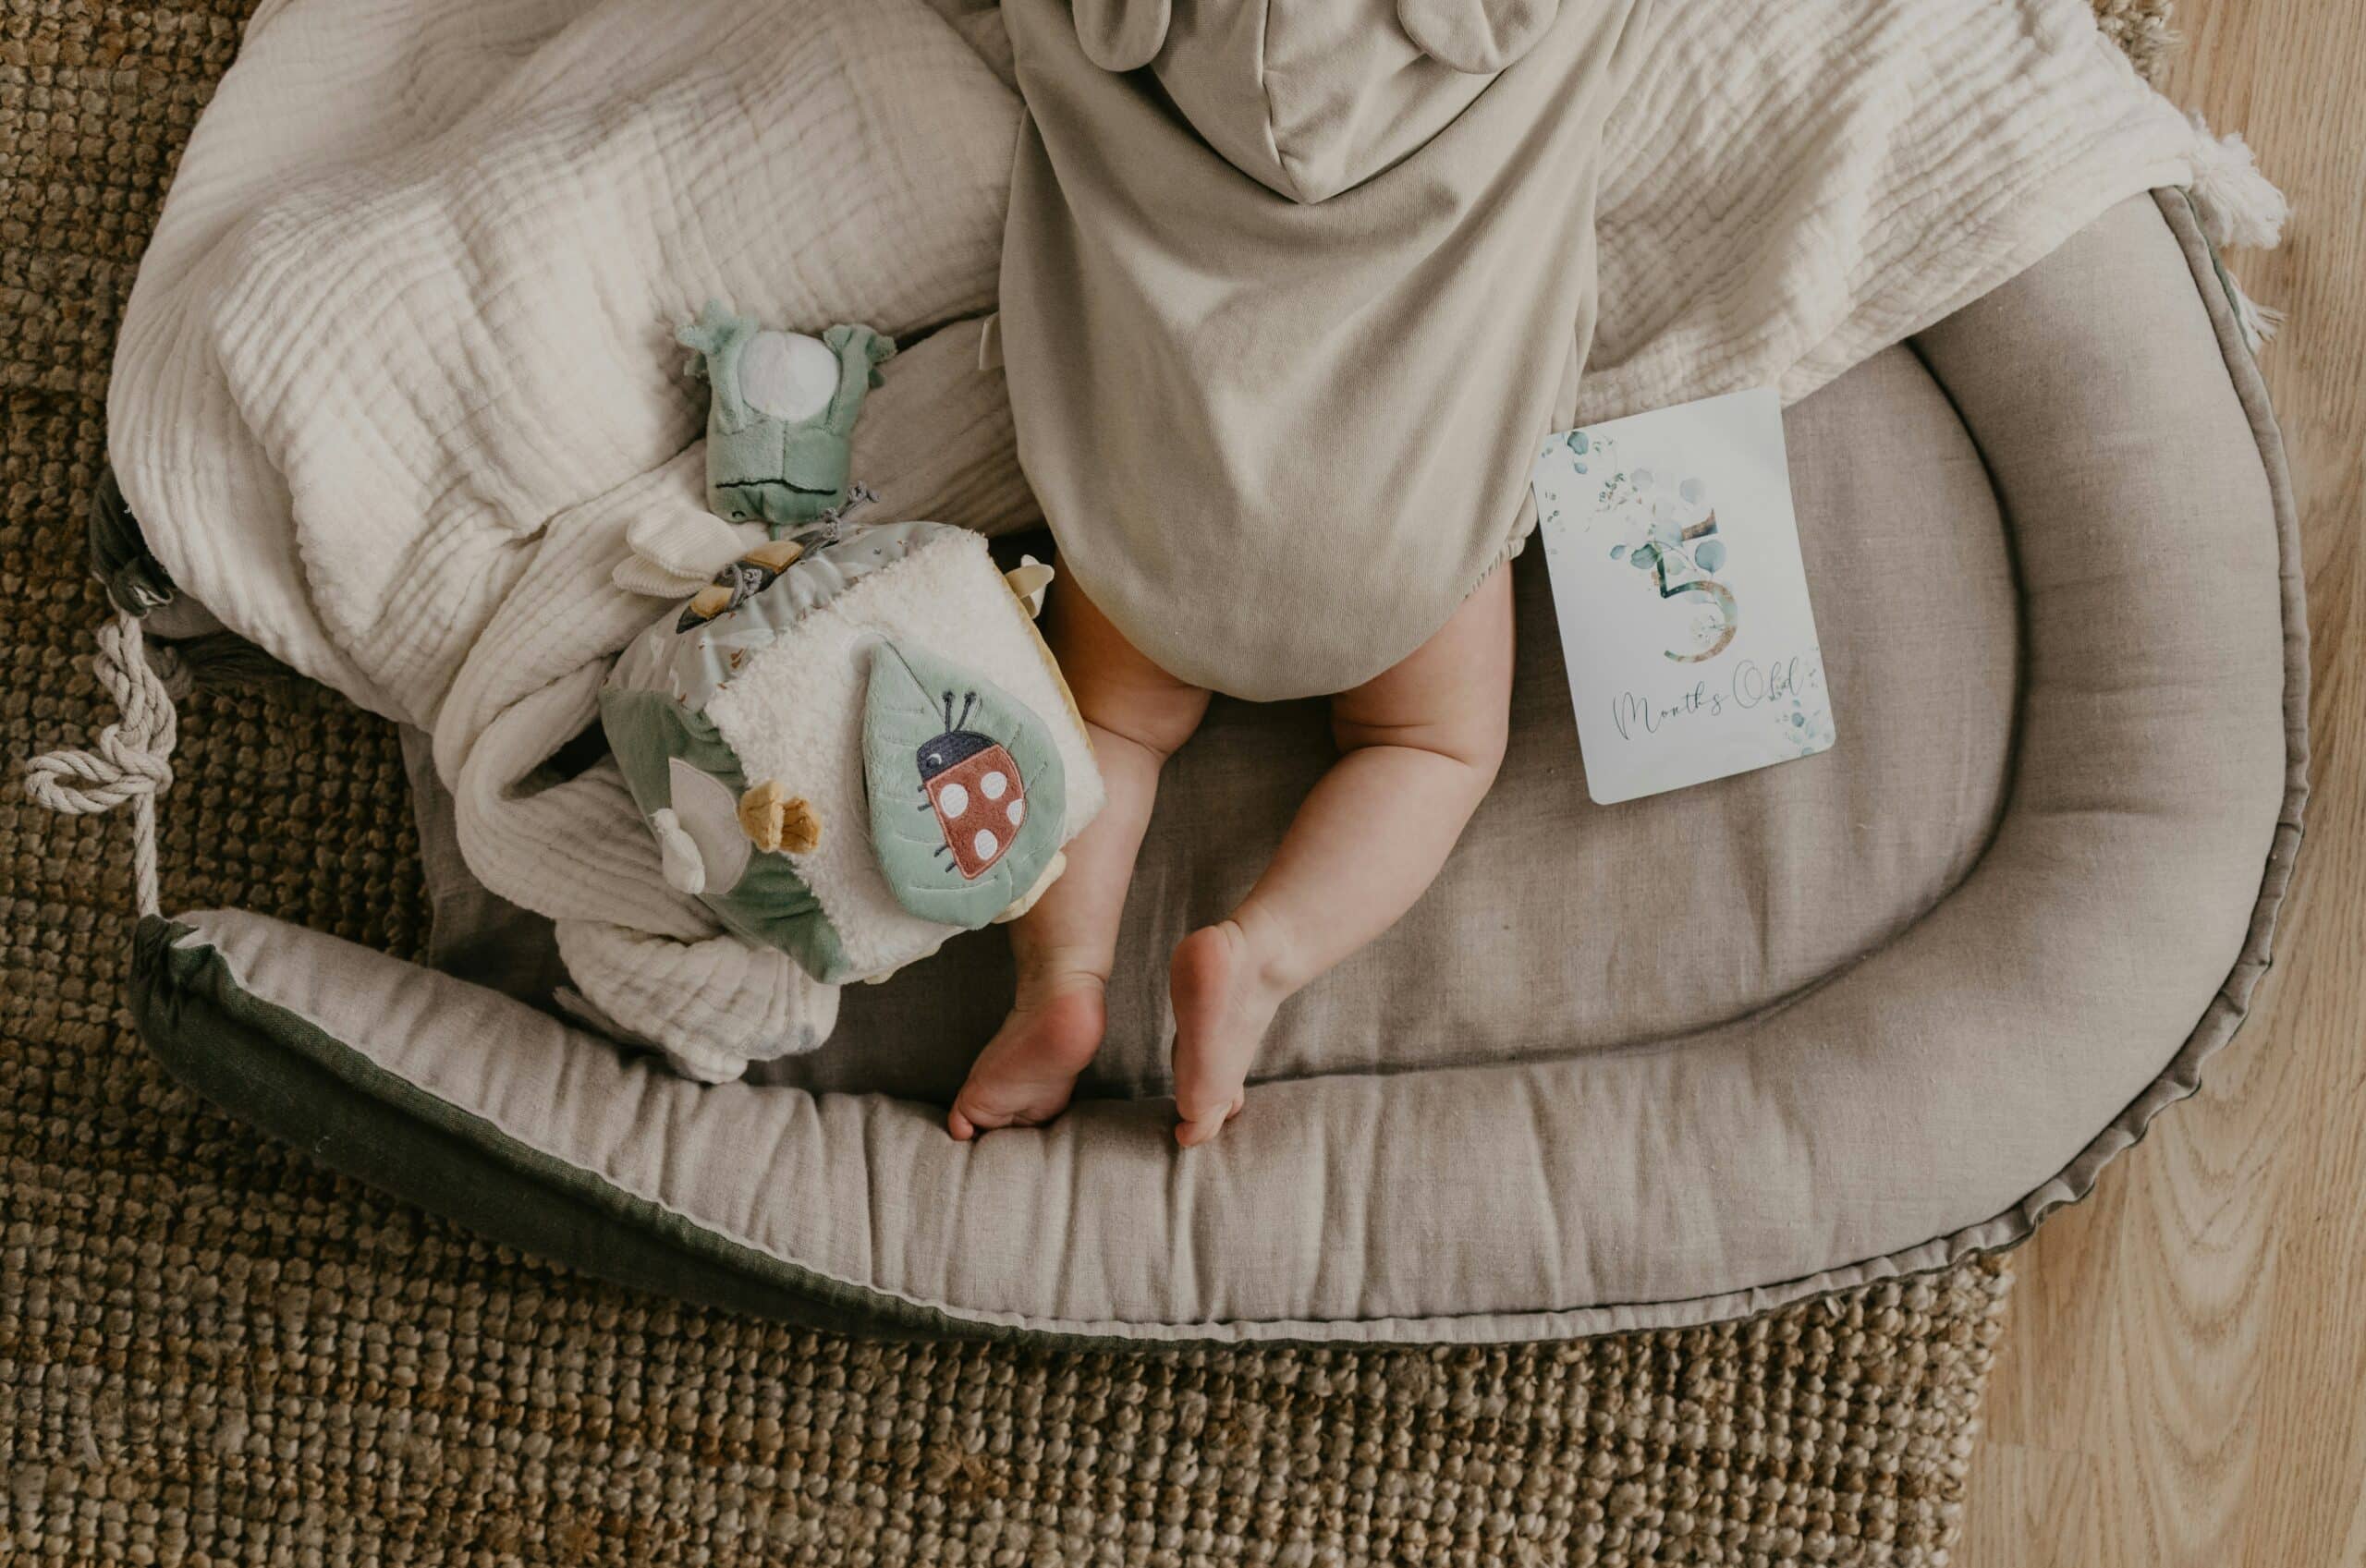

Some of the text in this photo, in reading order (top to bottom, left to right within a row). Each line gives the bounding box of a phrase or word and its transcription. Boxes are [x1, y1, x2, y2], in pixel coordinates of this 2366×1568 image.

[1657, 507, 1738, 663] 5
[1613, 656, 1804, 740] Months Old
